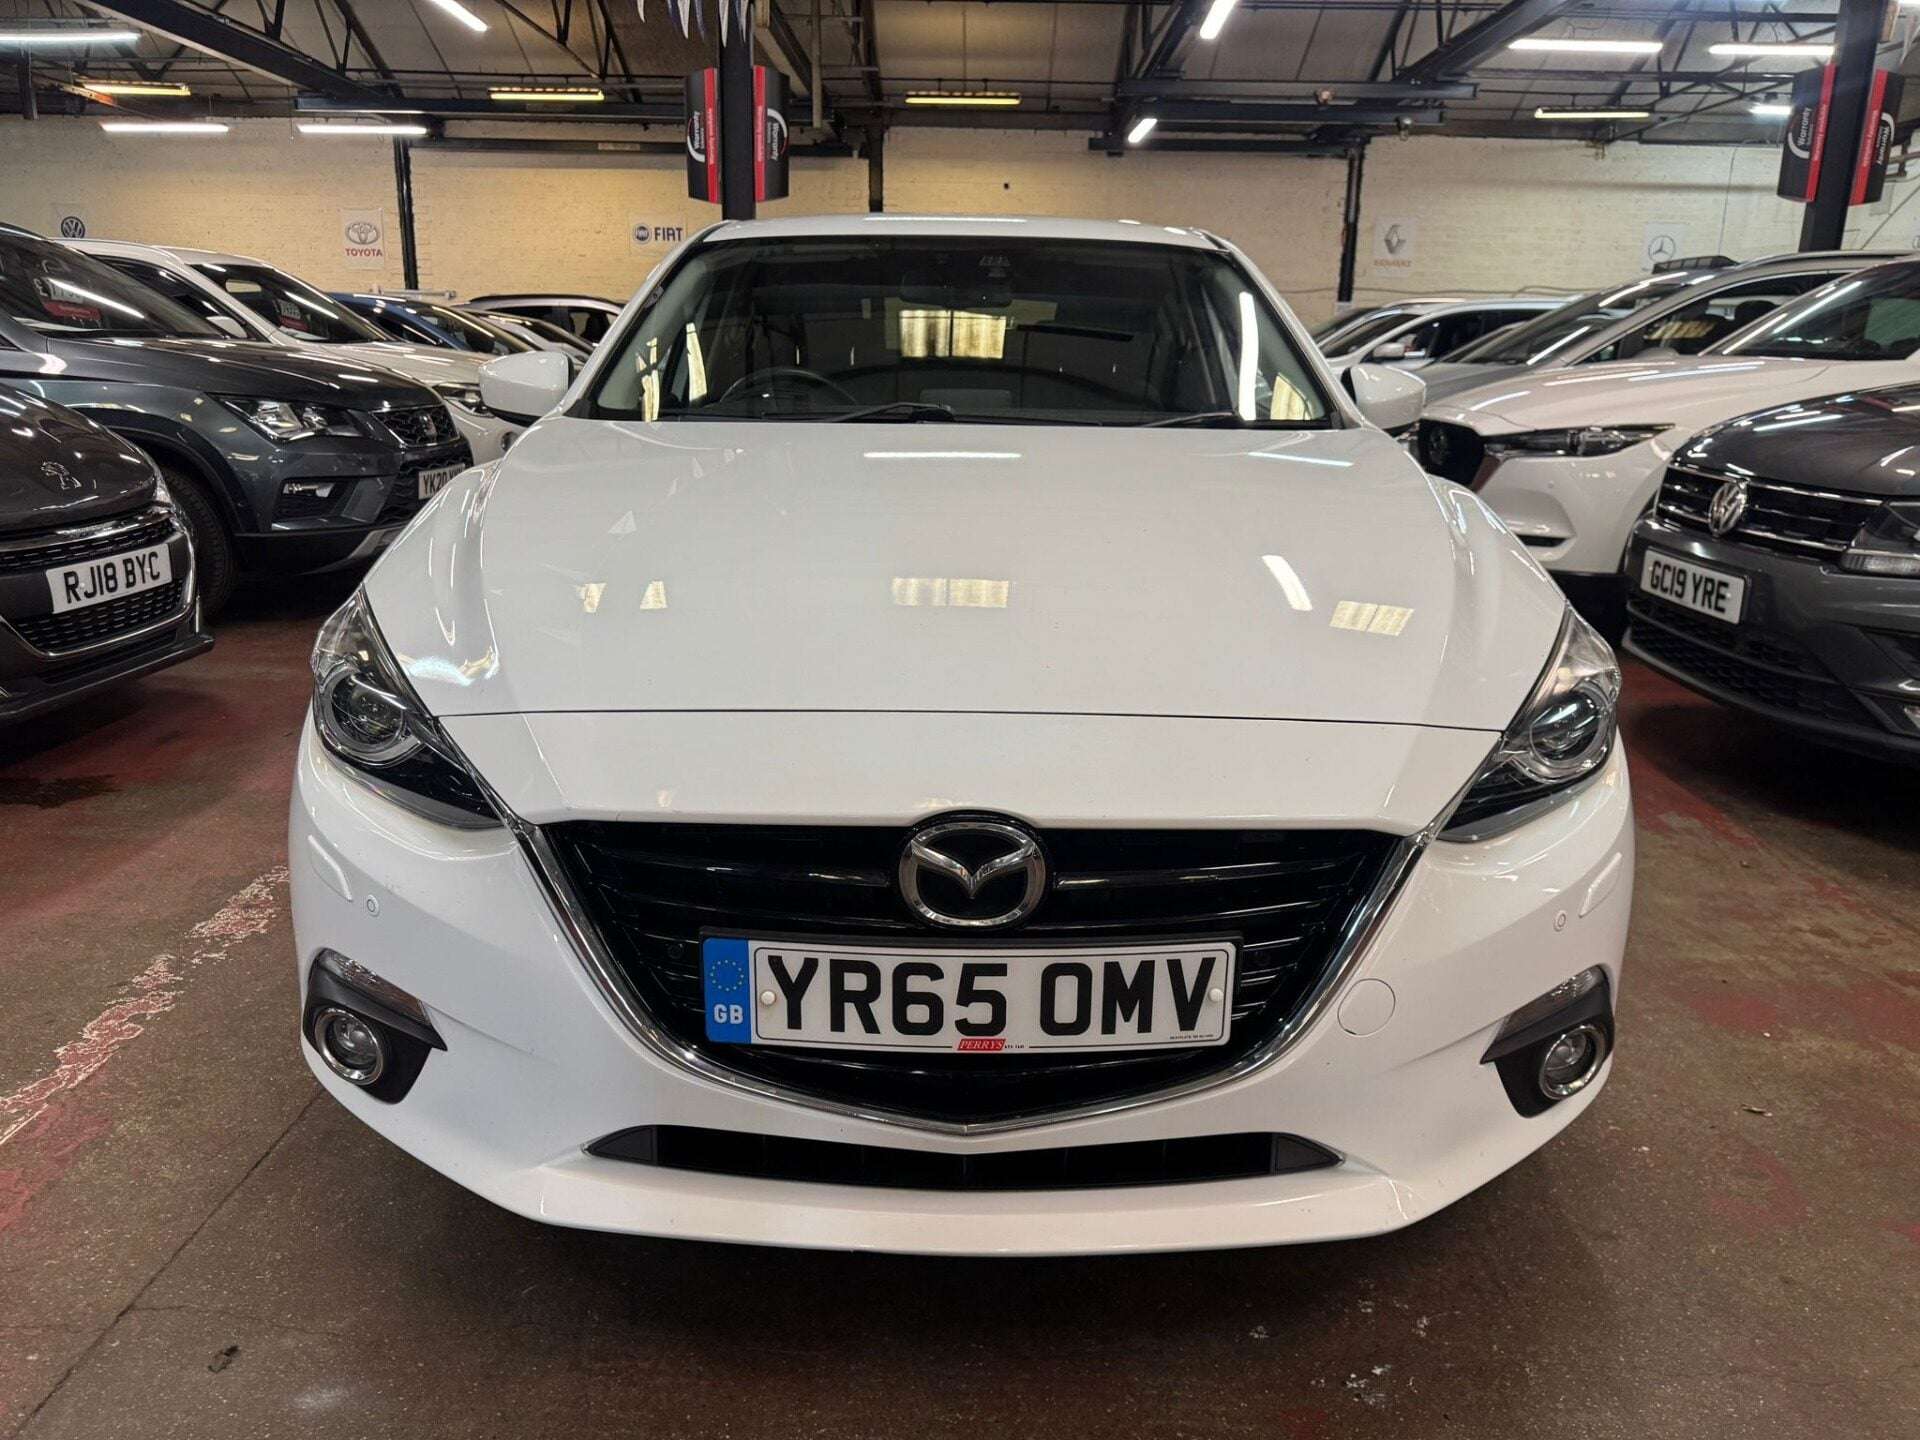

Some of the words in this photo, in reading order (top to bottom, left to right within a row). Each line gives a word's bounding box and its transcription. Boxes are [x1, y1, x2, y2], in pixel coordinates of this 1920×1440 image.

[693, 111, 701, 150] Warranty
[771, 122, 780, 161] Warranty
[1798, 107, 1812, 146] Warranty
[345, 248, 383, 257] TOYOTA
[654, 226, 683, 241] FIAT
[64, 562, 118, 604] RJ18
[123, 551, 160, 588] BYC
[1650, 560, 1687, 598] GC19
[1691, 571, 1729, 614] YRE
[713, 1003, 744, 1025] GB
[767, 955, 1008, 1037] YR65
[1039, 956, 1217, 1037] OMV
[960, 1040, 1004, 1050] PERRYS
